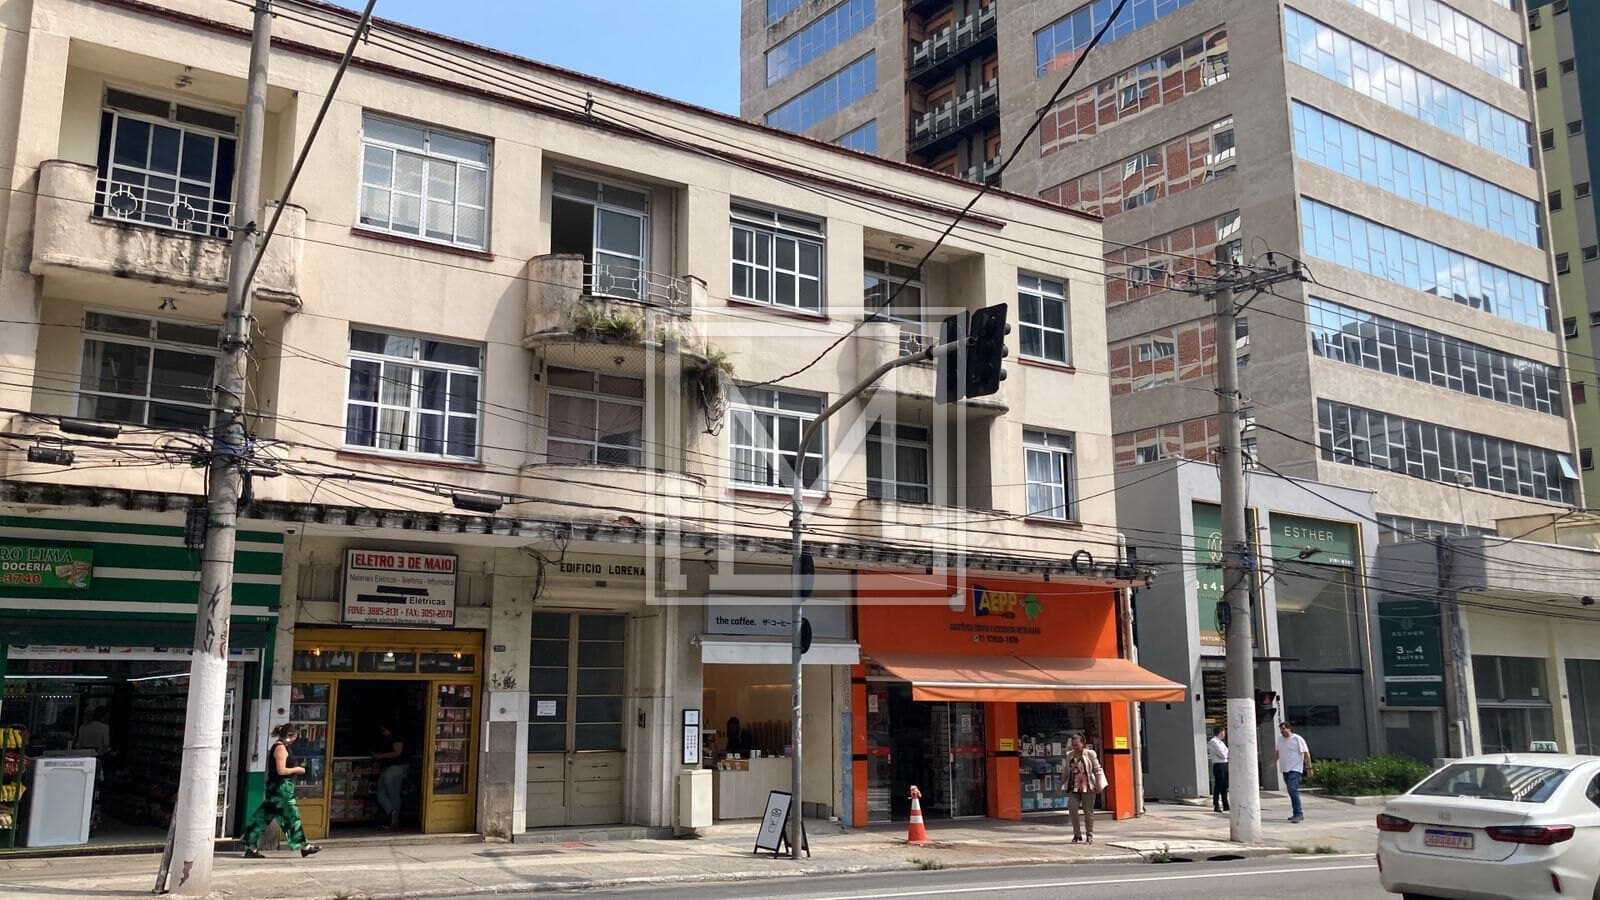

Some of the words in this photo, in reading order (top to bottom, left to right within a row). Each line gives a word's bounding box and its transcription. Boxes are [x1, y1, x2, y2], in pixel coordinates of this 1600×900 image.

[1284, 526, 1334, 542] ESTHER
[28, 547, 73, 562] LIMA
[2, 562, 52, 571] DOCERIA
[355, 553, 395, 567] ELETRO
[397, 556, 405, 568] 3
[408, 557, 421, 569] DE
[424, 558, 452, 570] MAIO
[560, 563, 601, 574] EDIFICIO
[609, 565, 646, 576] LORENA
[409, 597, 446, 605] Elétricas
[716, 616, 729, 625] the
[731, 616, 756, 626] coffee.
[1395, 646, 1404, 654] 3
[1415, 645, 1423, 653] 4
[1533, 742, 1554, 752] TAXI
